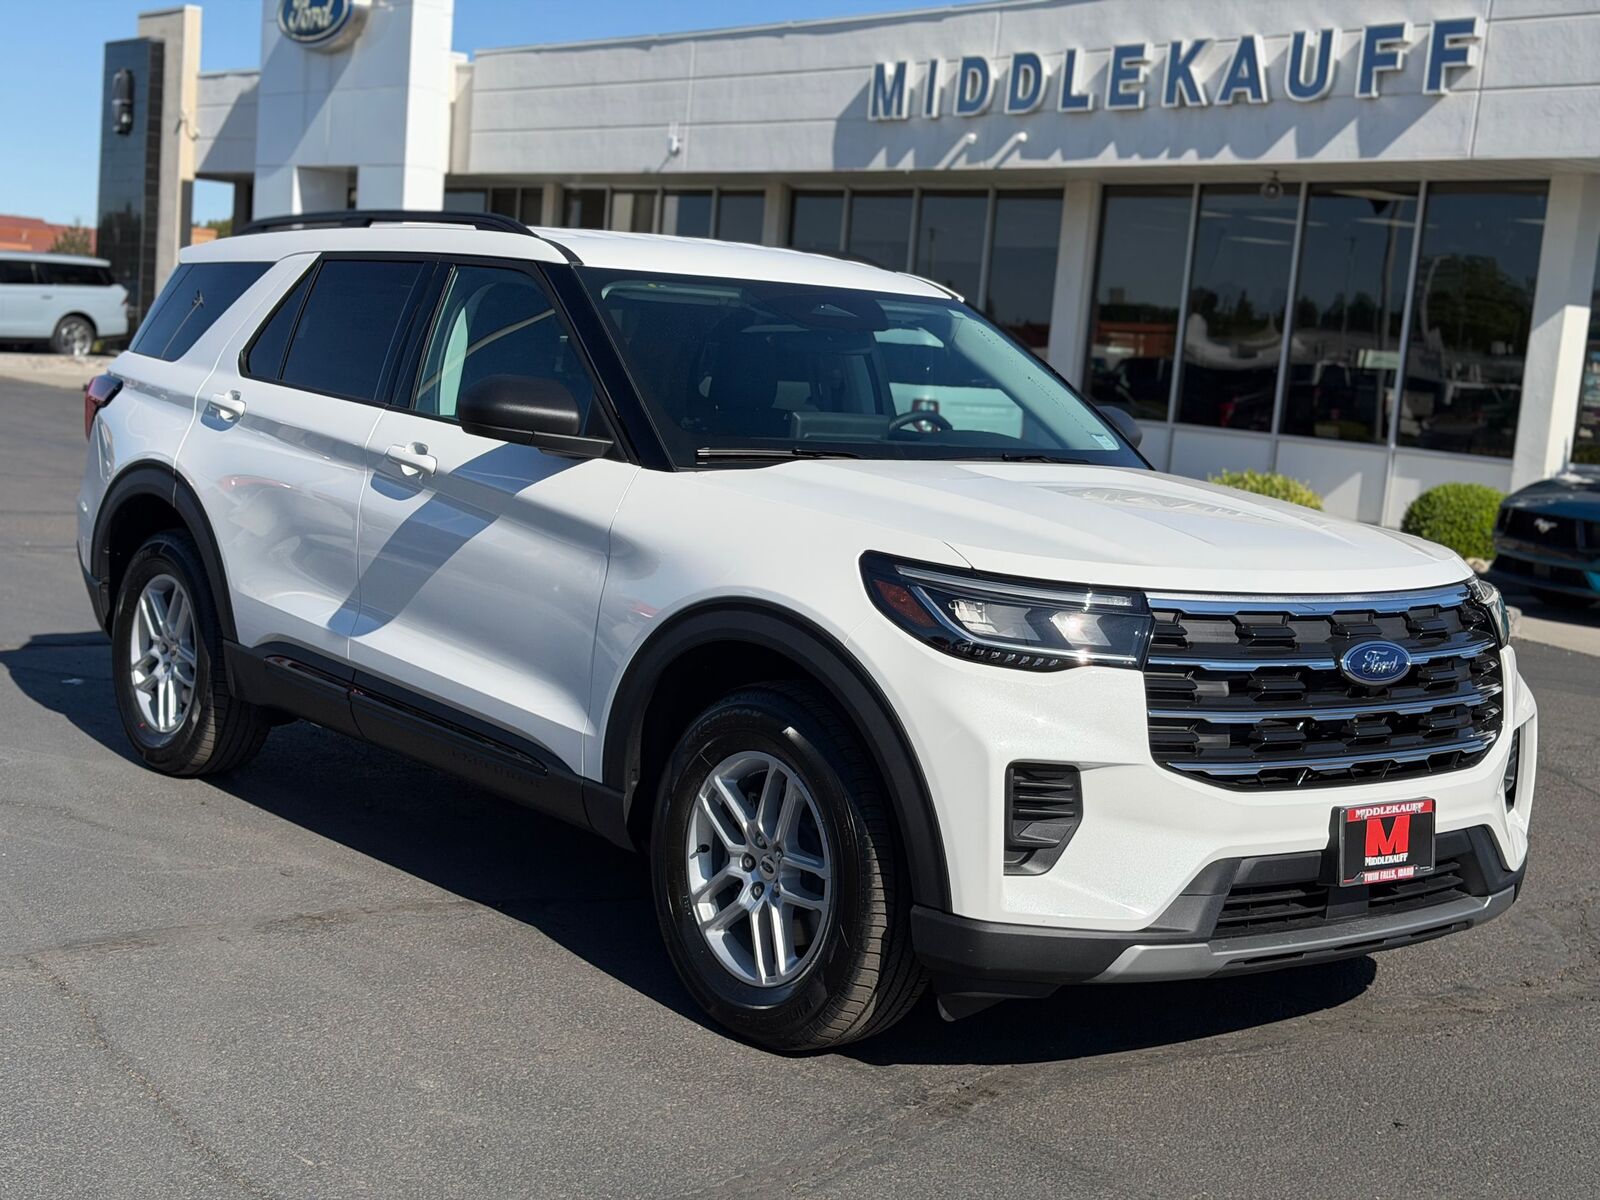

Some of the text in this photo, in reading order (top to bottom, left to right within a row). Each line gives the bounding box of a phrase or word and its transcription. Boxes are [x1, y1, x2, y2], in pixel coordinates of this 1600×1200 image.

[868, 18, 1480, 121] MIDDLEKAUFF
[1362, 650, 1398, 674] Ford
[1355, 802, 1424, 819] MIDDLEKAUFF
[1365, 815, 1410, 856] M
[1364, 853, 1408, 866] MIDDLEKAUFF
[1364, 872, 1379, 882] TWIN
[1380, 868, 1397, 879] FALLS,
[1397, 867, 1414, 877] IDAHO
